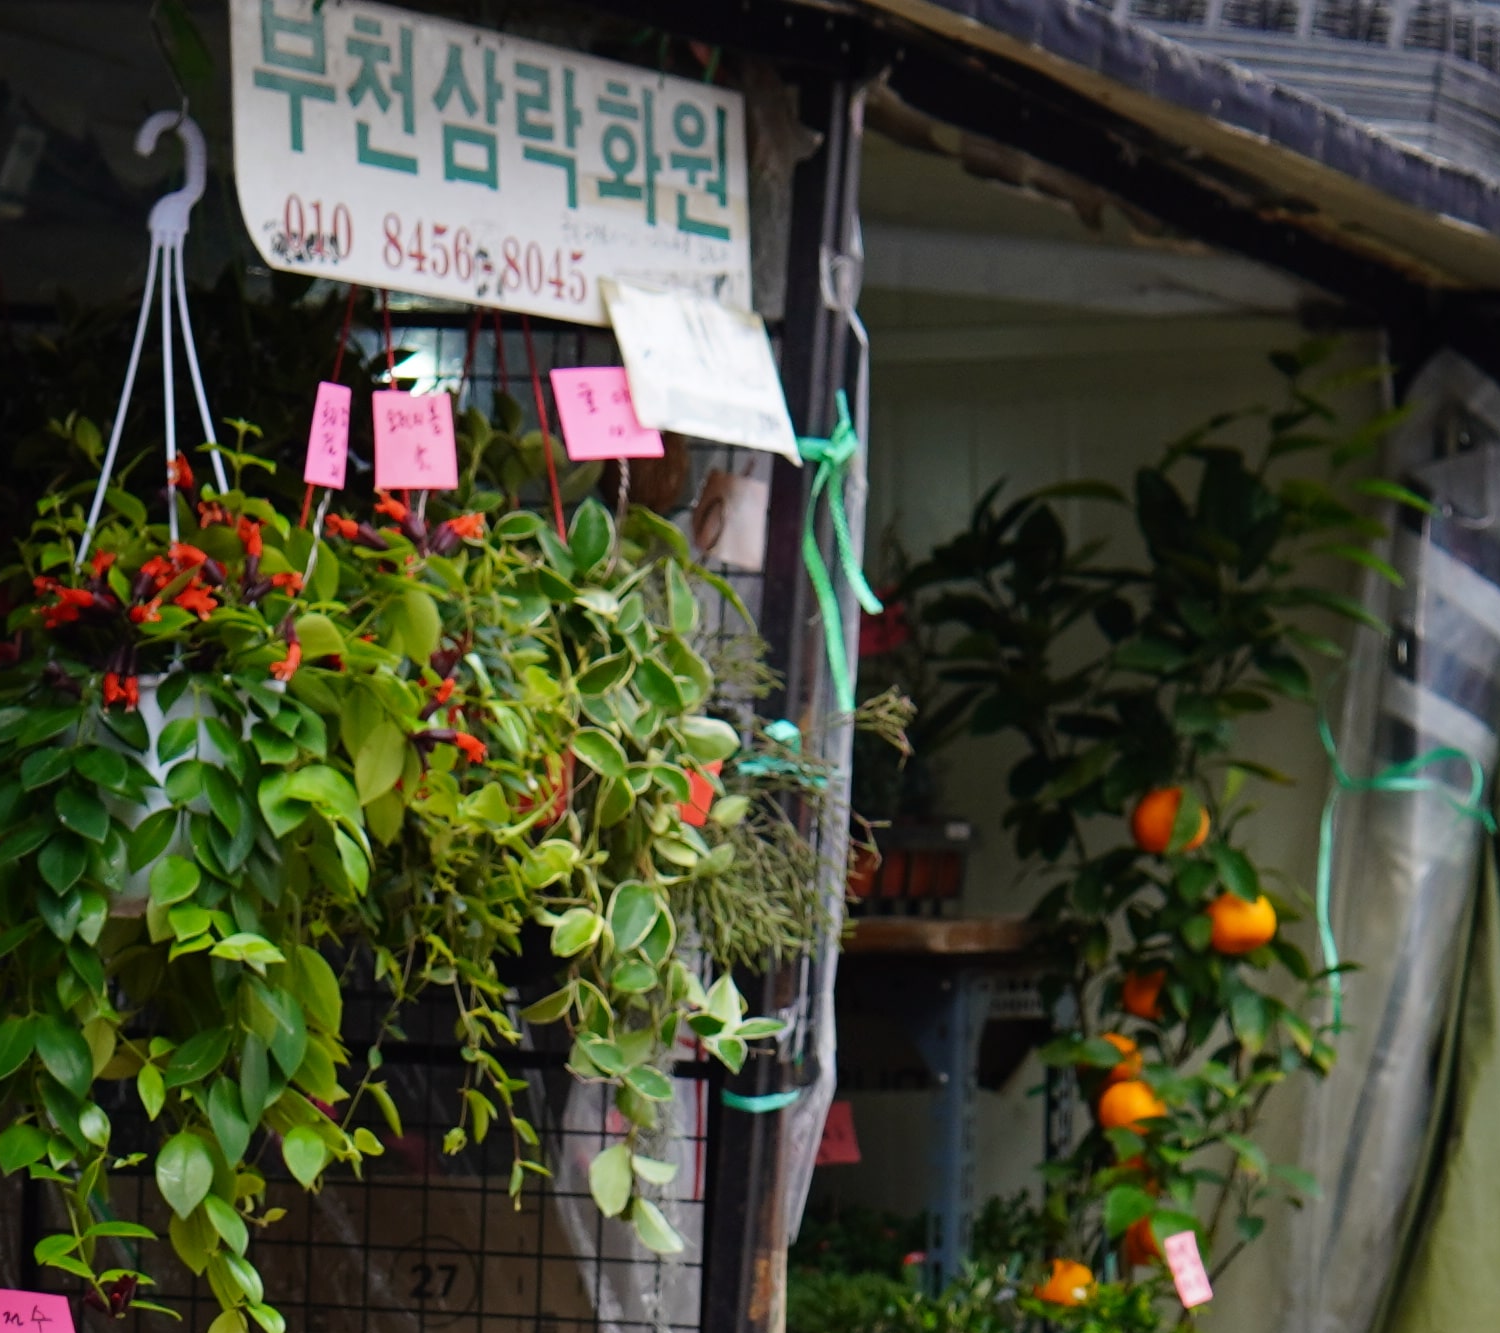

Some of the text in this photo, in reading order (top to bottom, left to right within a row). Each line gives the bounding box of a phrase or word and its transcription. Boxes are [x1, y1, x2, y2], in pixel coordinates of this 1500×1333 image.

[253, 0, 730, 240] 부천삼락화원
[283, 194, 354, 260] 010
[382, 212, 588, 303] 8456-8045
[410, 1261, 460, 1301] 27
